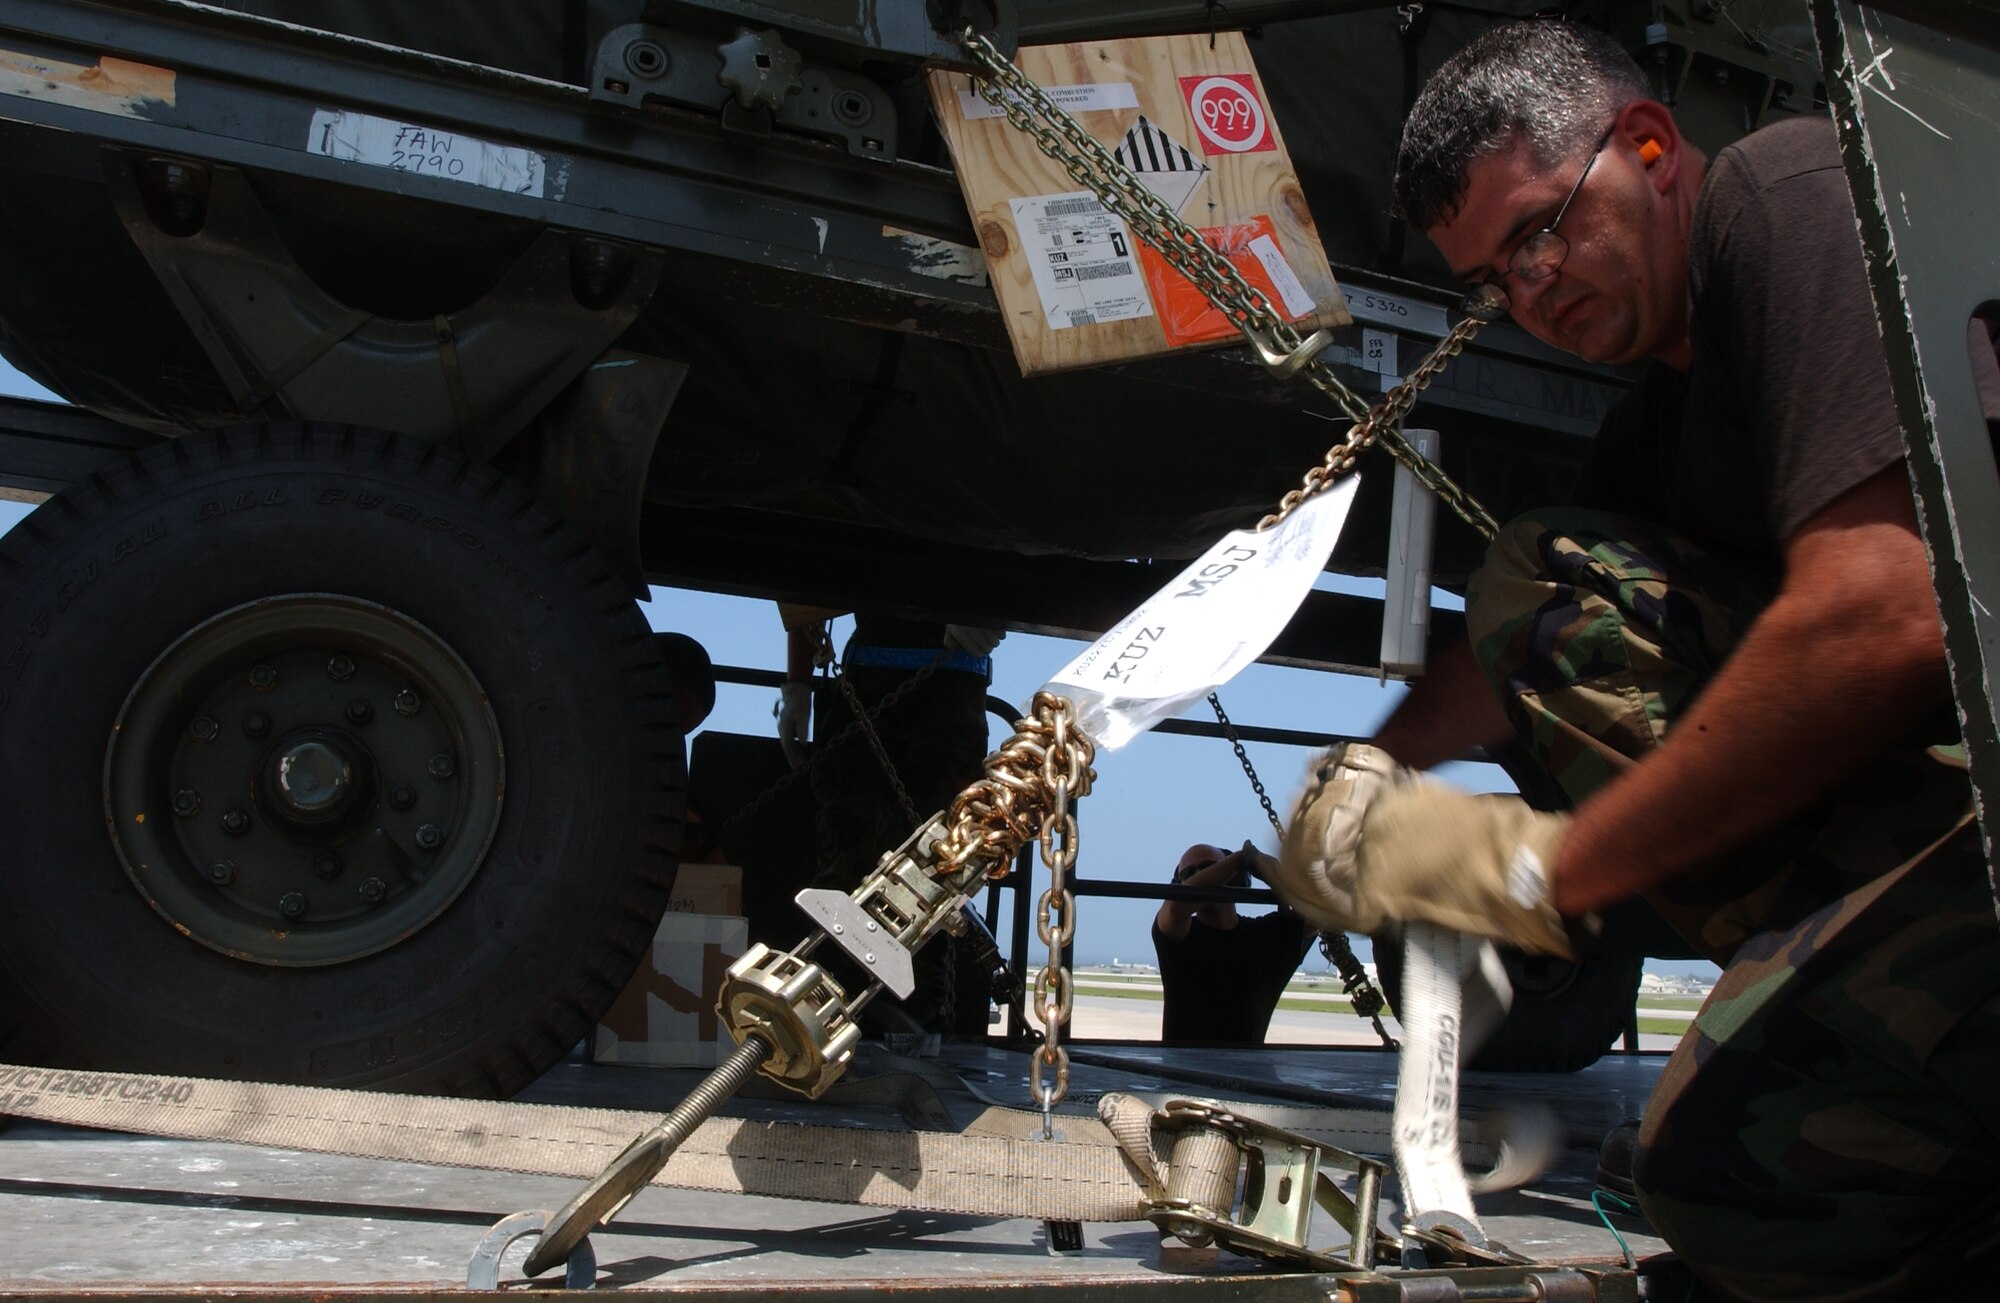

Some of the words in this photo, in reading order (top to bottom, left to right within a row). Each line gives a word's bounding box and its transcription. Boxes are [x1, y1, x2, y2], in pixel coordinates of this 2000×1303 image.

[1051, 87, 1096, 97] COMBUSTION
[1056, 95, 1089, 104] POWERED
[1200, 97, 1252, 132] 999
[395, 126, 454, 154] FAW
[389, 150, 465, 177] 2790
[1050, 253, 1066, 263] KUZ
[1056, 269, 1072, 278] MSJ
[1364, 295, 1408, 316] 5320
[193, 487, 287, 523] ALL
[1103, 626, 1166, 684] KUZ
[1174, 544, 1258, 600] MSJ
